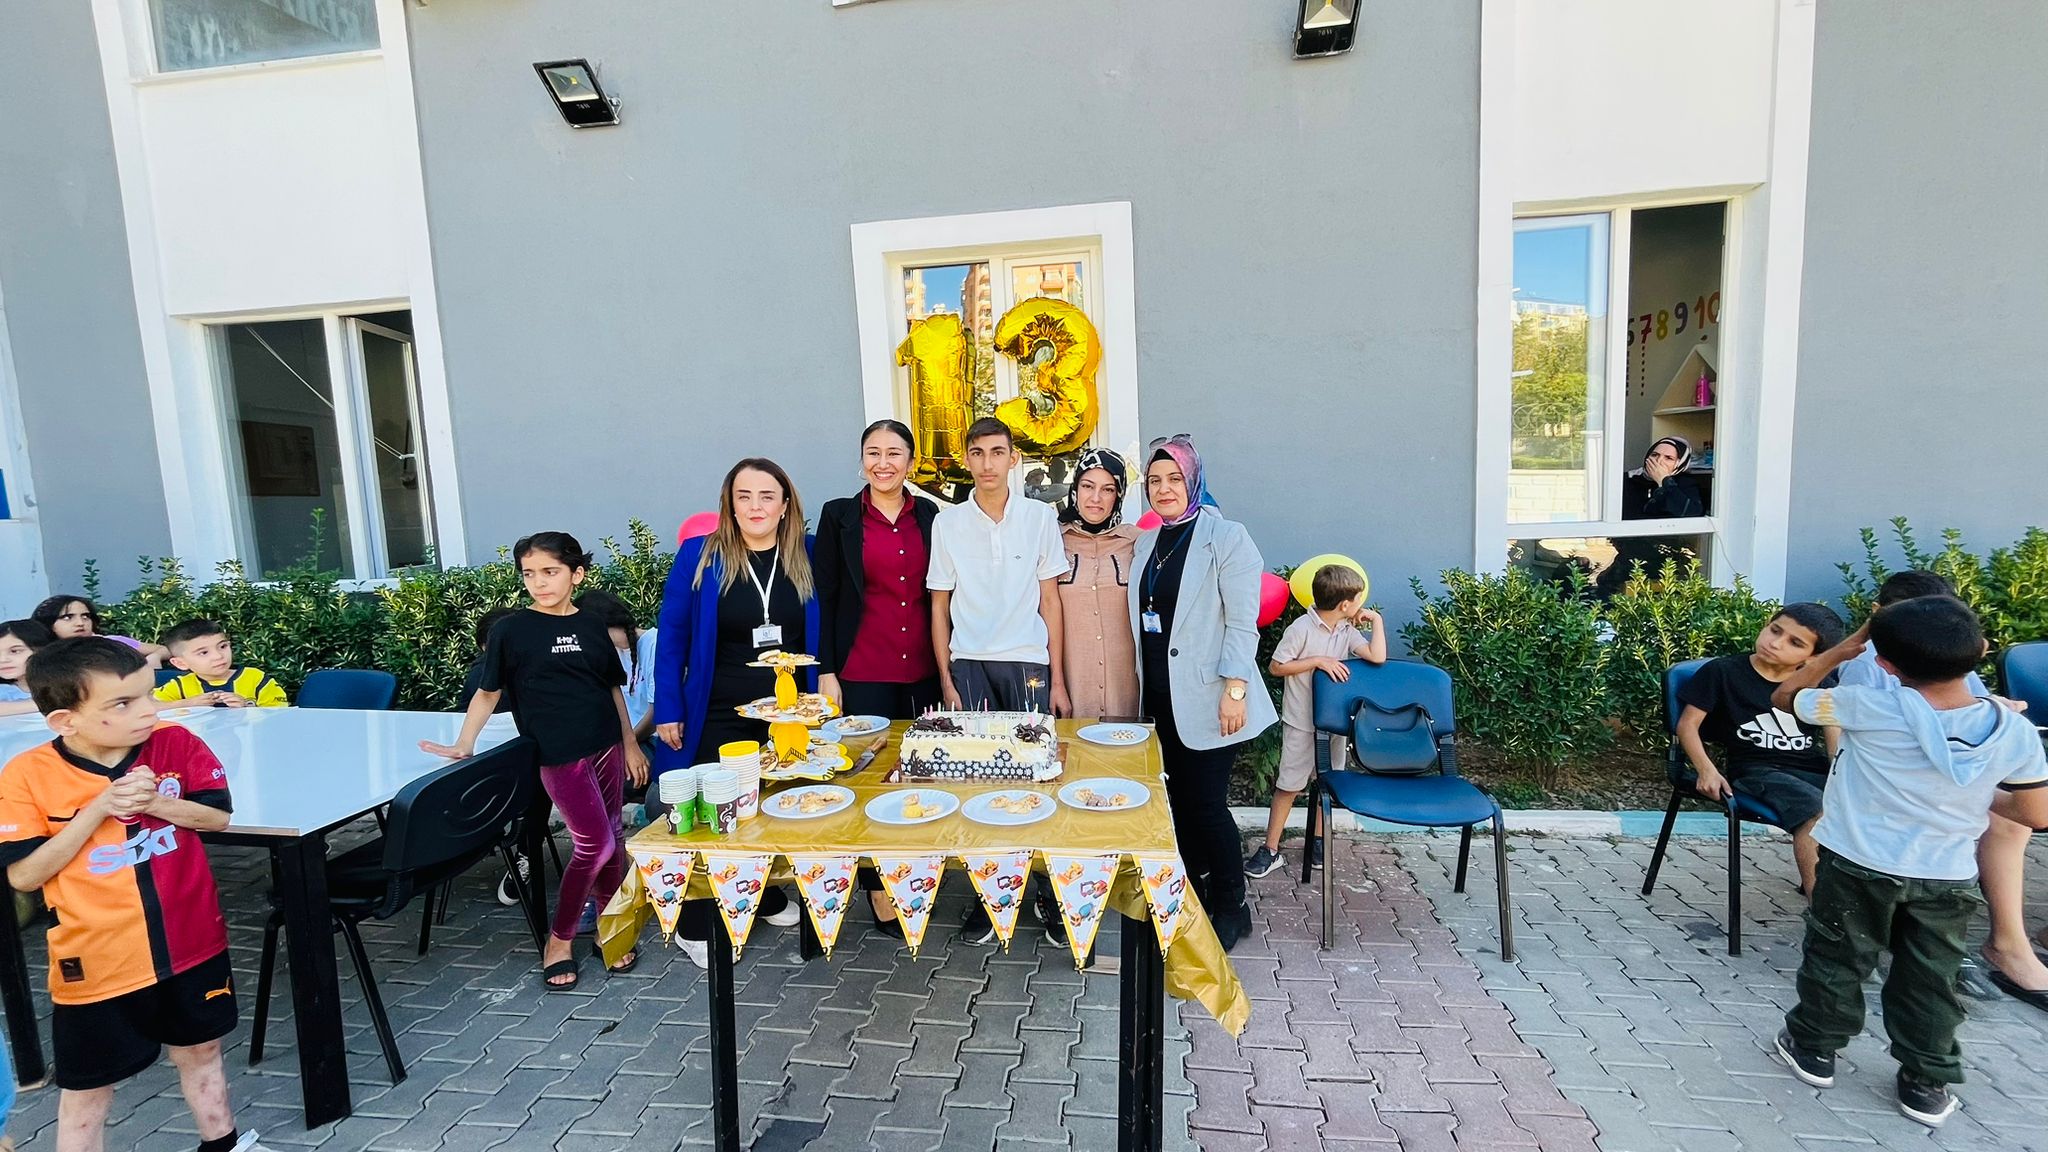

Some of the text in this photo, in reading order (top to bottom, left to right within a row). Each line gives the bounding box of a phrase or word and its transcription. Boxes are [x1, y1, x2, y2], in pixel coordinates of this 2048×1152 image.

[1640, 313, 1652, 344] 7
[1656, 309, 1669, 341] 8
[1674, 302, 1688, 335] 9
[1694, 290, 1720, 329] 10
[1737, 728, 1813, 751] adidas
